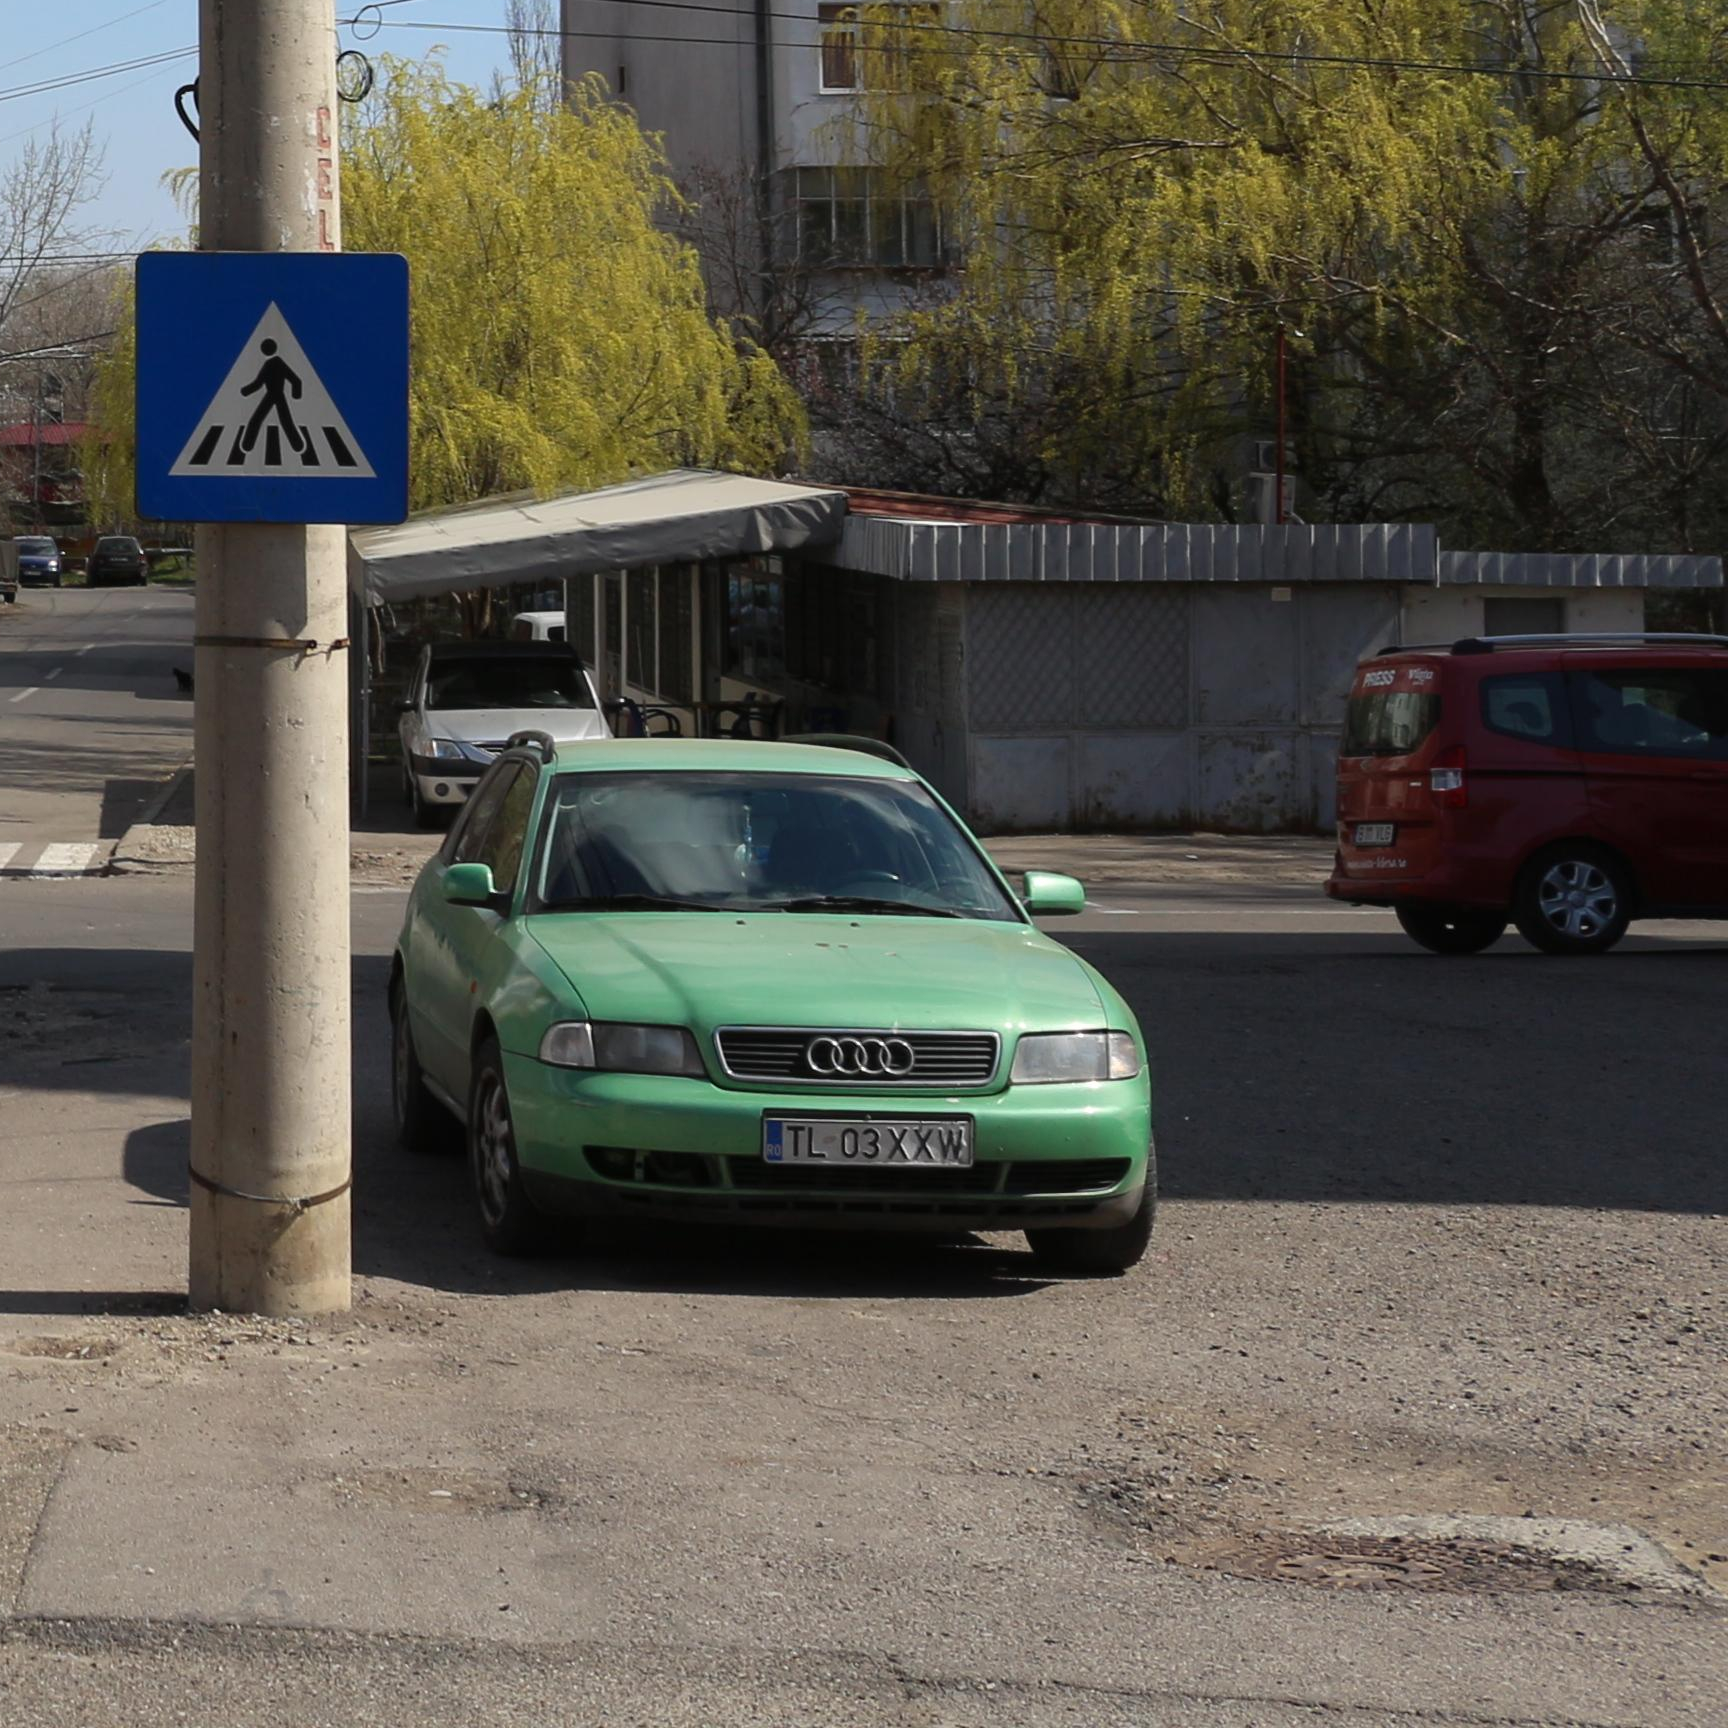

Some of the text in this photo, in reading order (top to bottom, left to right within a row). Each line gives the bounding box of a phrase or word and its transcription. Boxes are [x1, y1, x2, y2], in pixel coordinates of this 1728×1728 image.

[1362, 670, 1396, 688] PRESS
[767, 1143, 781, 1157] RO
[786, 1126, 827, 1158] TL
